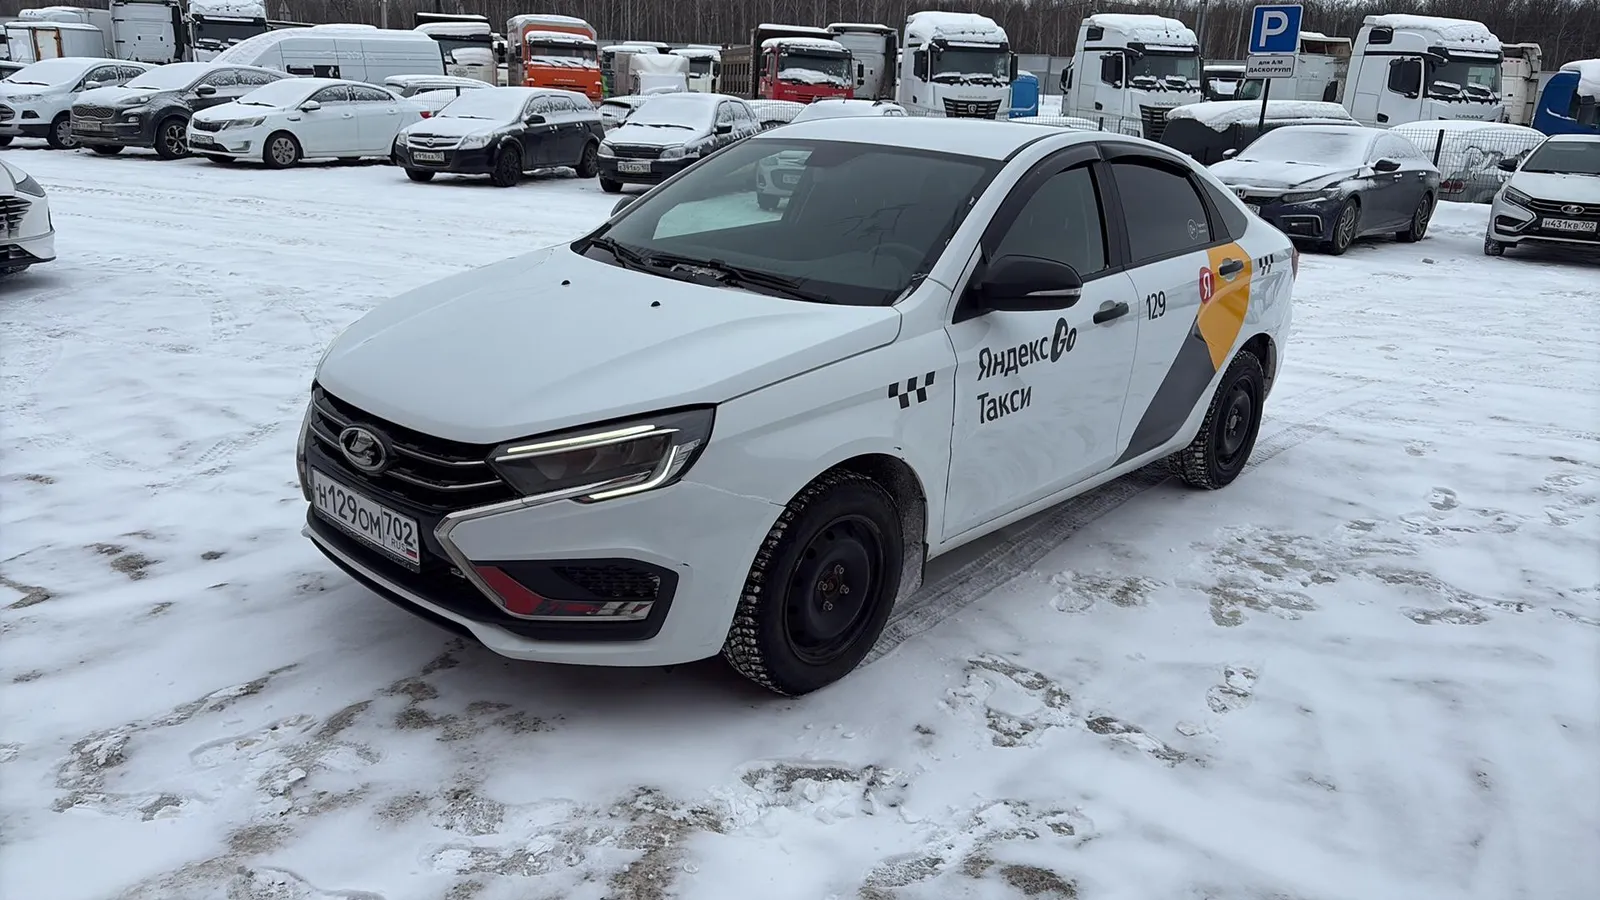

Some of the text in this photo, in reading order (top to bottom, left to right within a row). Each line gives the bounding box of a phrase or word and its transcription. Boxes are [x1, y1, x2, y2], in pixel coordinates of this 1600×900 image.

[1146, 290, 1166, 320] 129
[977, 317, 1077, 381] Яндекс Go
[977, 386, 1032, 424] Такси
[383, 511, 413, 547] 702
[391, 538, 406, 552] RUS
